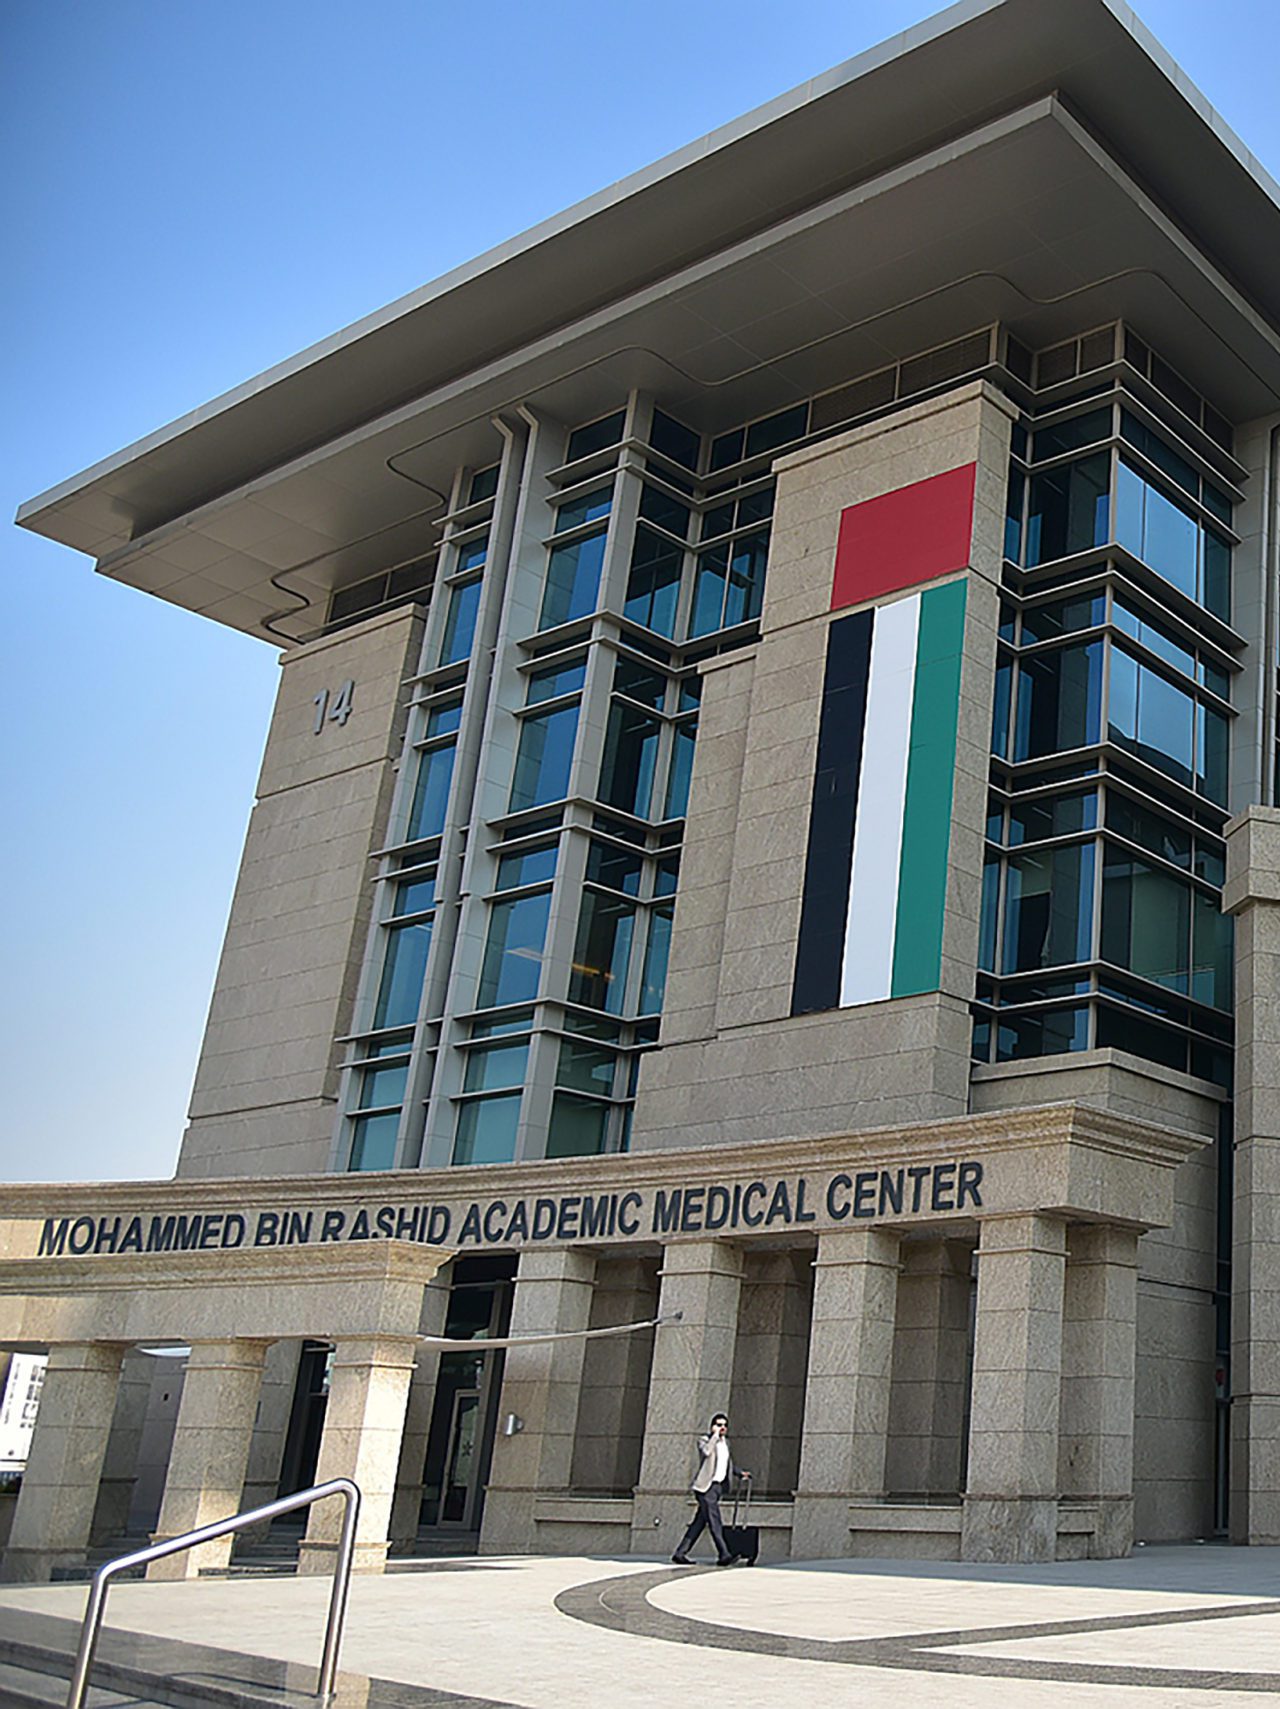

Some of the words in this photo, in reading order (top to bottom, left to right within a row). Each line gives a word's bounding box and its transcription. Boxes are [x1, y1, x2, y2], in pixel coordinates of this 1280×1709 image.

[313, 679, 355, 736] 14
[37, 1213, 245, 1256] MOHAMMED
[254, 1210, 313, 1246] BIN
[320, 1206, 452, 1246] RASHID
[457, 1192, 642, 1245] ACADEMIC
[651, 1178, 816, 1233] MEDICAL
[826, 1161, 984, 1220] CENTER
